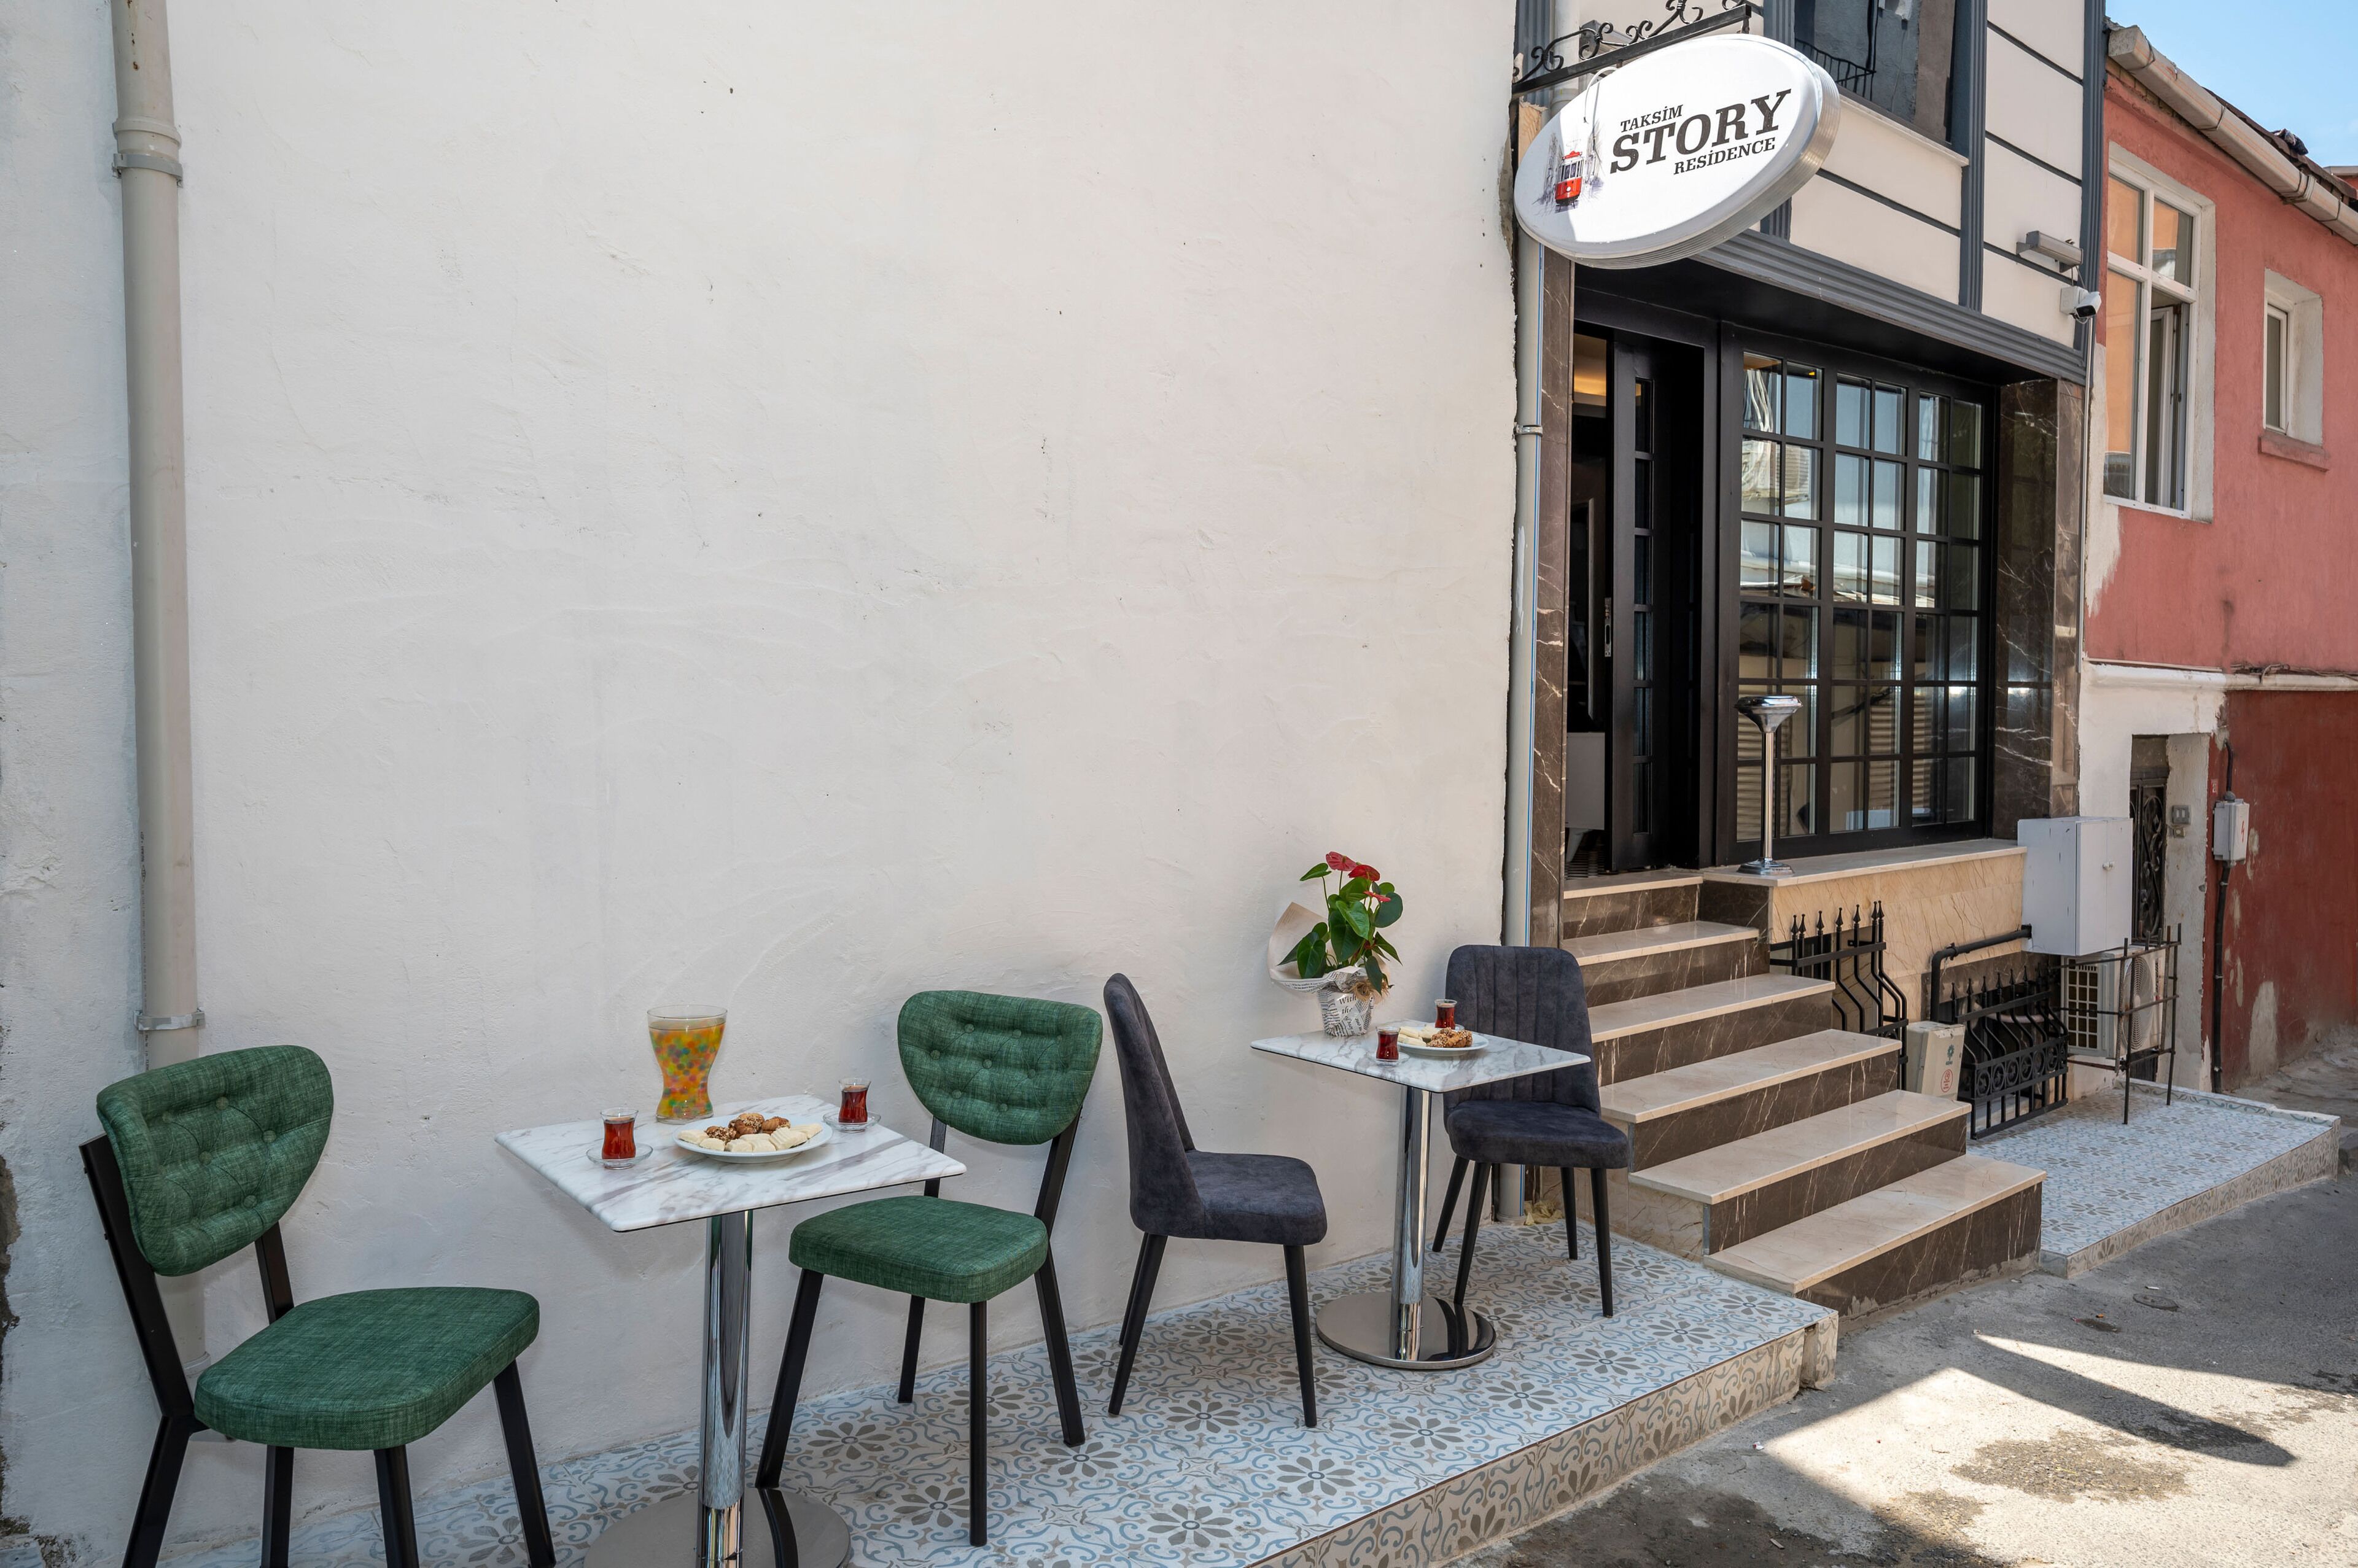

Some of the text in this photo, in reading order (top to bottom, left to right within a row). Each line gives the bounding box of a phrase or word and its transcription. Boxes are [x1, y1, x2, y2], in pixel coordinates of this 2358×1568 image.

[1609, 88, 1792, 174] STORY
[1620, 104, 1684, 133] TAKSİM
[1673, 137, 1776, 175] RESİDENCE
